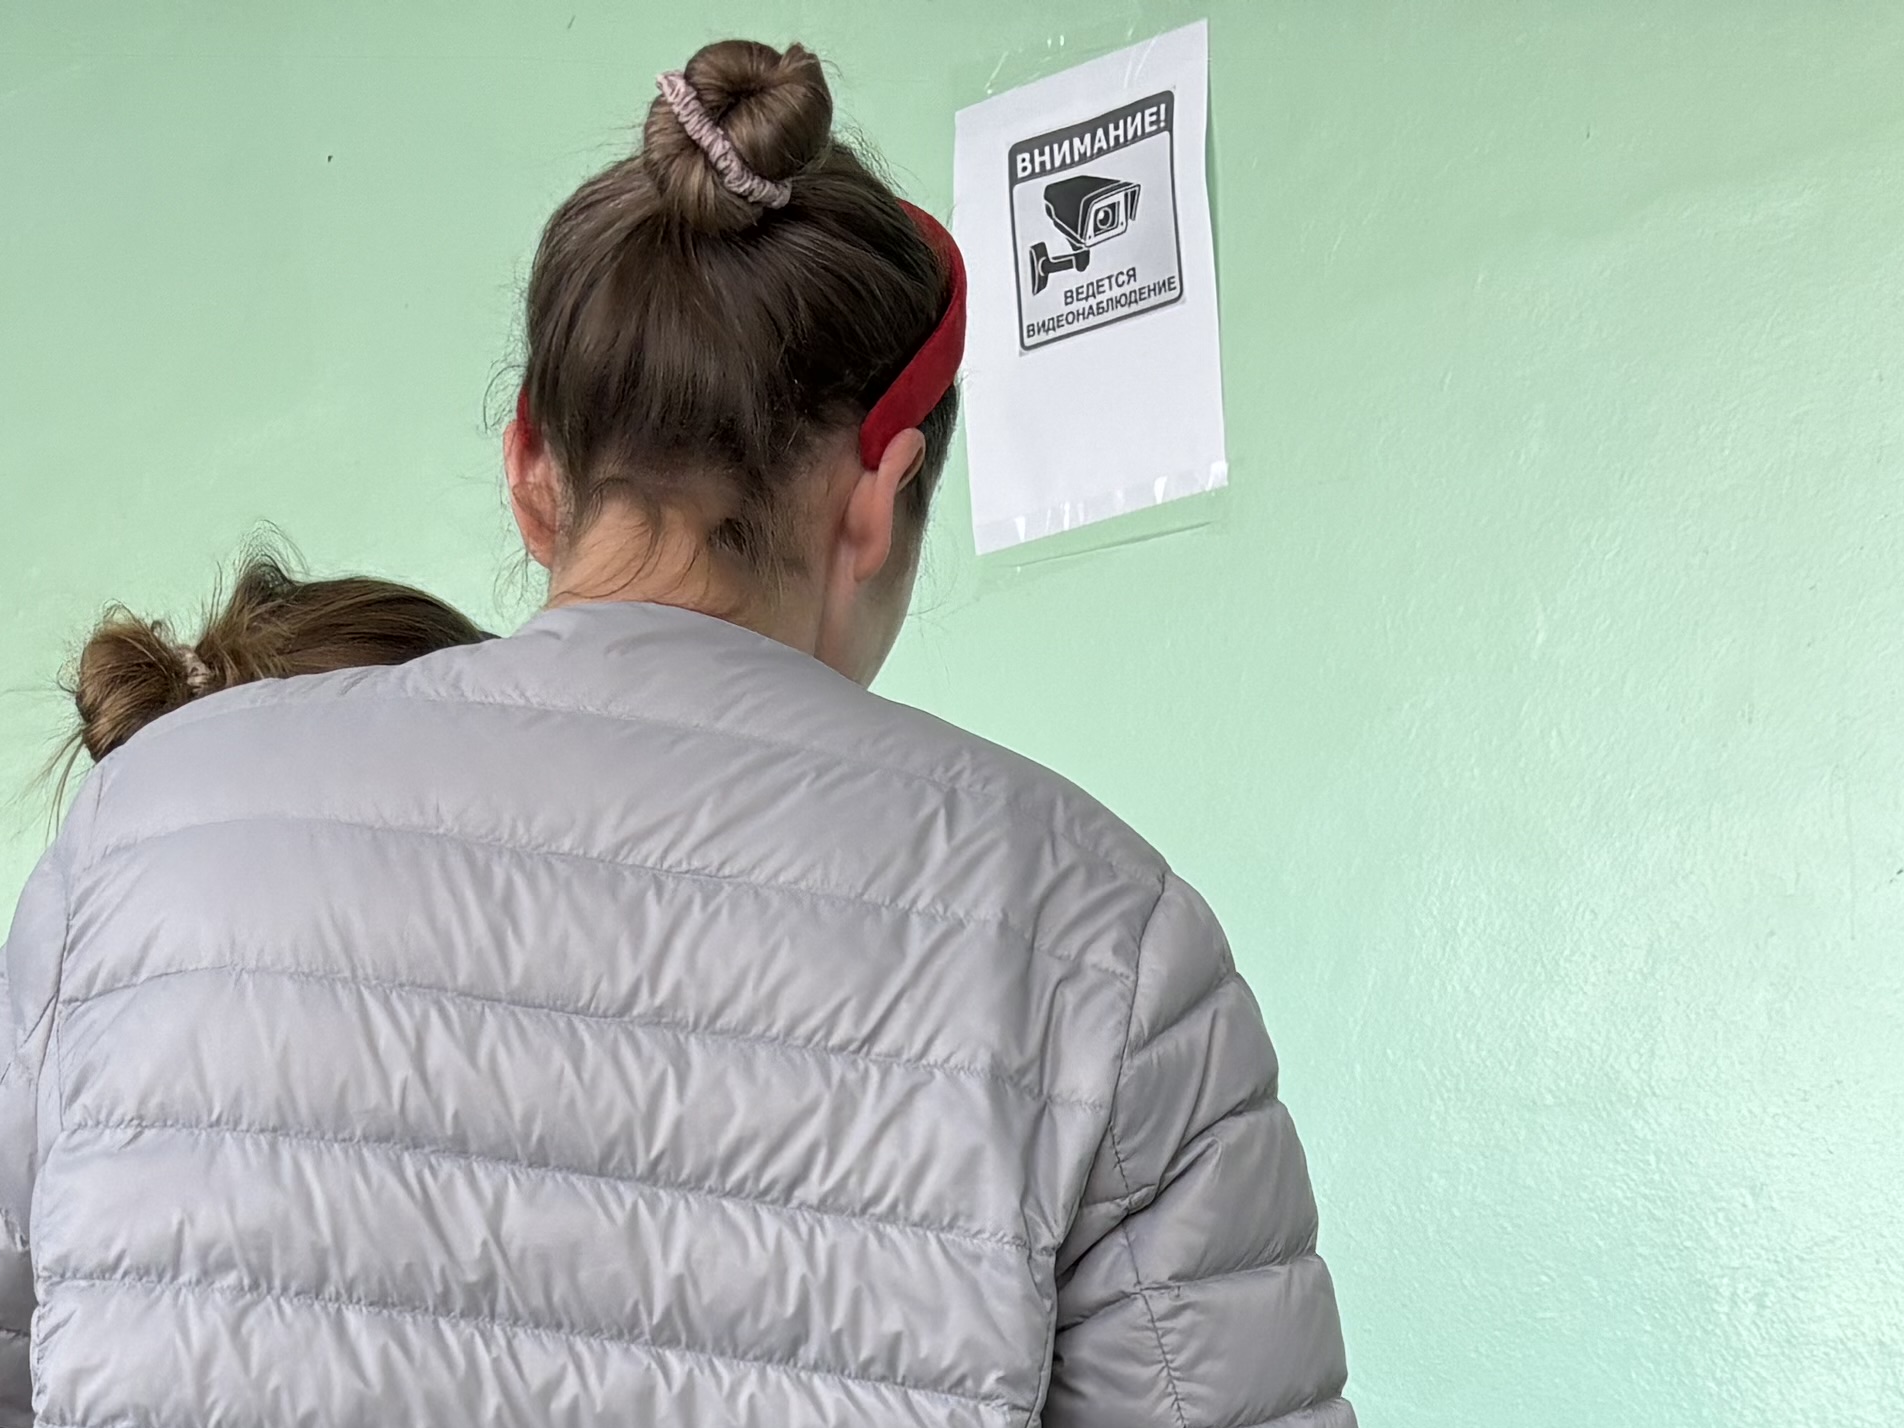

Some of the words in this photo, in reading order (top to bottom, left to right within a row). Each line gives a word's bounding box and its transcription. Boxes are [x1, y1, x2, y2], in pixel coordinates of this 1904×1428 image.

[1016, 103, 1166, 178] ВНИМАНИЕ!
[1026, 275, 1177, 338] ВИДЕОНАБЛЮДЕНИЕ
[1064, 266, 1137, 306] ВЕДЕТСЯ
